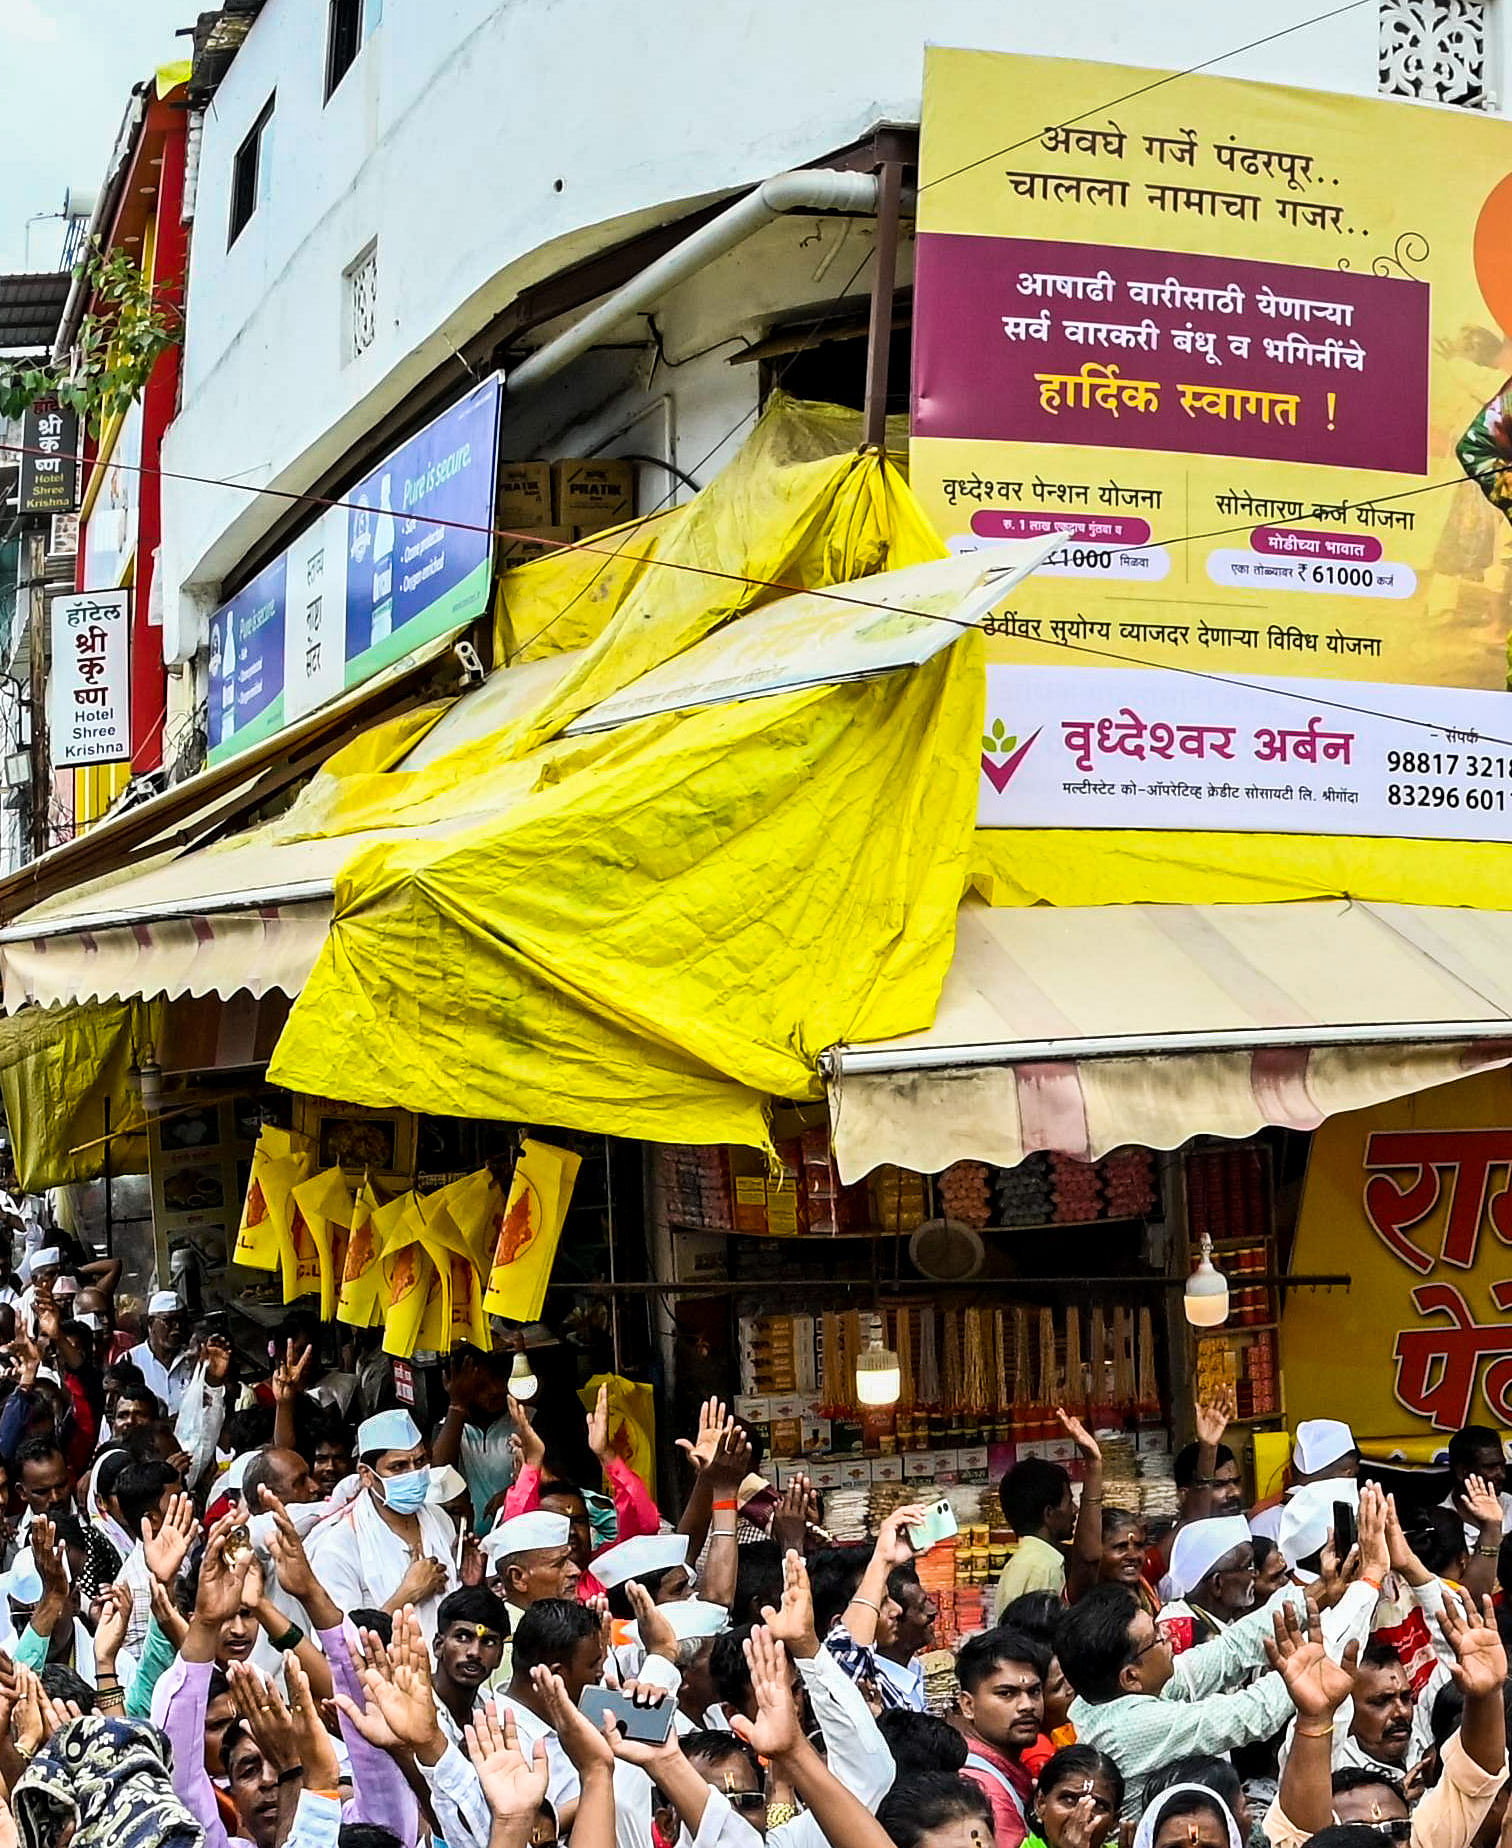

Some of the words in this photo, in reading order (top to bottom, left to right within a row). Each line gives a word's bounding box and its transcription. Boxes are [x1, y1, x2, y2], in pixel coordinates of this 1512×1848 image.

[1040, 120, 1127, 159] अवघे
[1142, 127, 1198, 167] गर्जे
[1006, 171, 1130, 207] चालला
[1145, 184, 1261, 222] नामाचा
[1276, 199, 1369, 236] गजर..
[1016, 270, 1116, 302] आषाढी
[1127, 277, 1245, 314] वारीसाठी
[1002, 309, 1051, 342] सर्व
[1062, 319, 1160, 350] वारकरी
[1170, 322, 1222, 365] बंधू
[1227, 336, 1250, 359] व
[1263, 333, 1366, 371] भगिनींचे
[1034, 361, 1160, 418] हार्दिक
[1177, 384, 1300, 426] स्वागत
[1327, 392, 1336, 431] !
[38, 413, 63, 435] श्री
[33, 485, 65, 496] Shree
[35, 473, 64, 484] Hotel
[402, 474, 426, 511] Pure
[425, 462, 435, 493] is
[570, 483, 622, 496] PRATIK
[26, 498, 70, 509] Krishna
[1032, 475, 1089, 506] पेन्शन
[1098, 479, 1163, 510] योजना
[1215, 492, 1303, 522] सोनेतारण
[1311, 500, 1349, 527] कर्ज
[1355, 502, 1415, 533] योजना
[1323, 540, 1365, 558] भावात
[1231, 561, 1250, 576] एका
[1297, 564, 1307, 584] ₹
[1311, 565, 1374, 588] 61000
[66, 601, 122, 627] हॉटेल
[75, 625, 108, 655] श्री
[1050, 613, 1111, 649] सुयोग्य
[1120, 619, 1190, 646] व्याजदर
[1267, 625, 1318, 653] विविध
[1326, 627, 1381, 657] योजना
[75, 708, 114, 723] Hotel
[72, 726, 116, 740] Shree
[1253, 715, 1355, 766] अर्बन
[65, 742, 124, 758] Krishna
[1388, 751, 1458, 777] 98817
[1062, 779, 1116, 796] मल्टीस्टेट
[1244, 783, 1293, 801] सोसायटी
[1298, 786, 1317, 802] लि.
[1388, 784, 1460, 809] 83296
